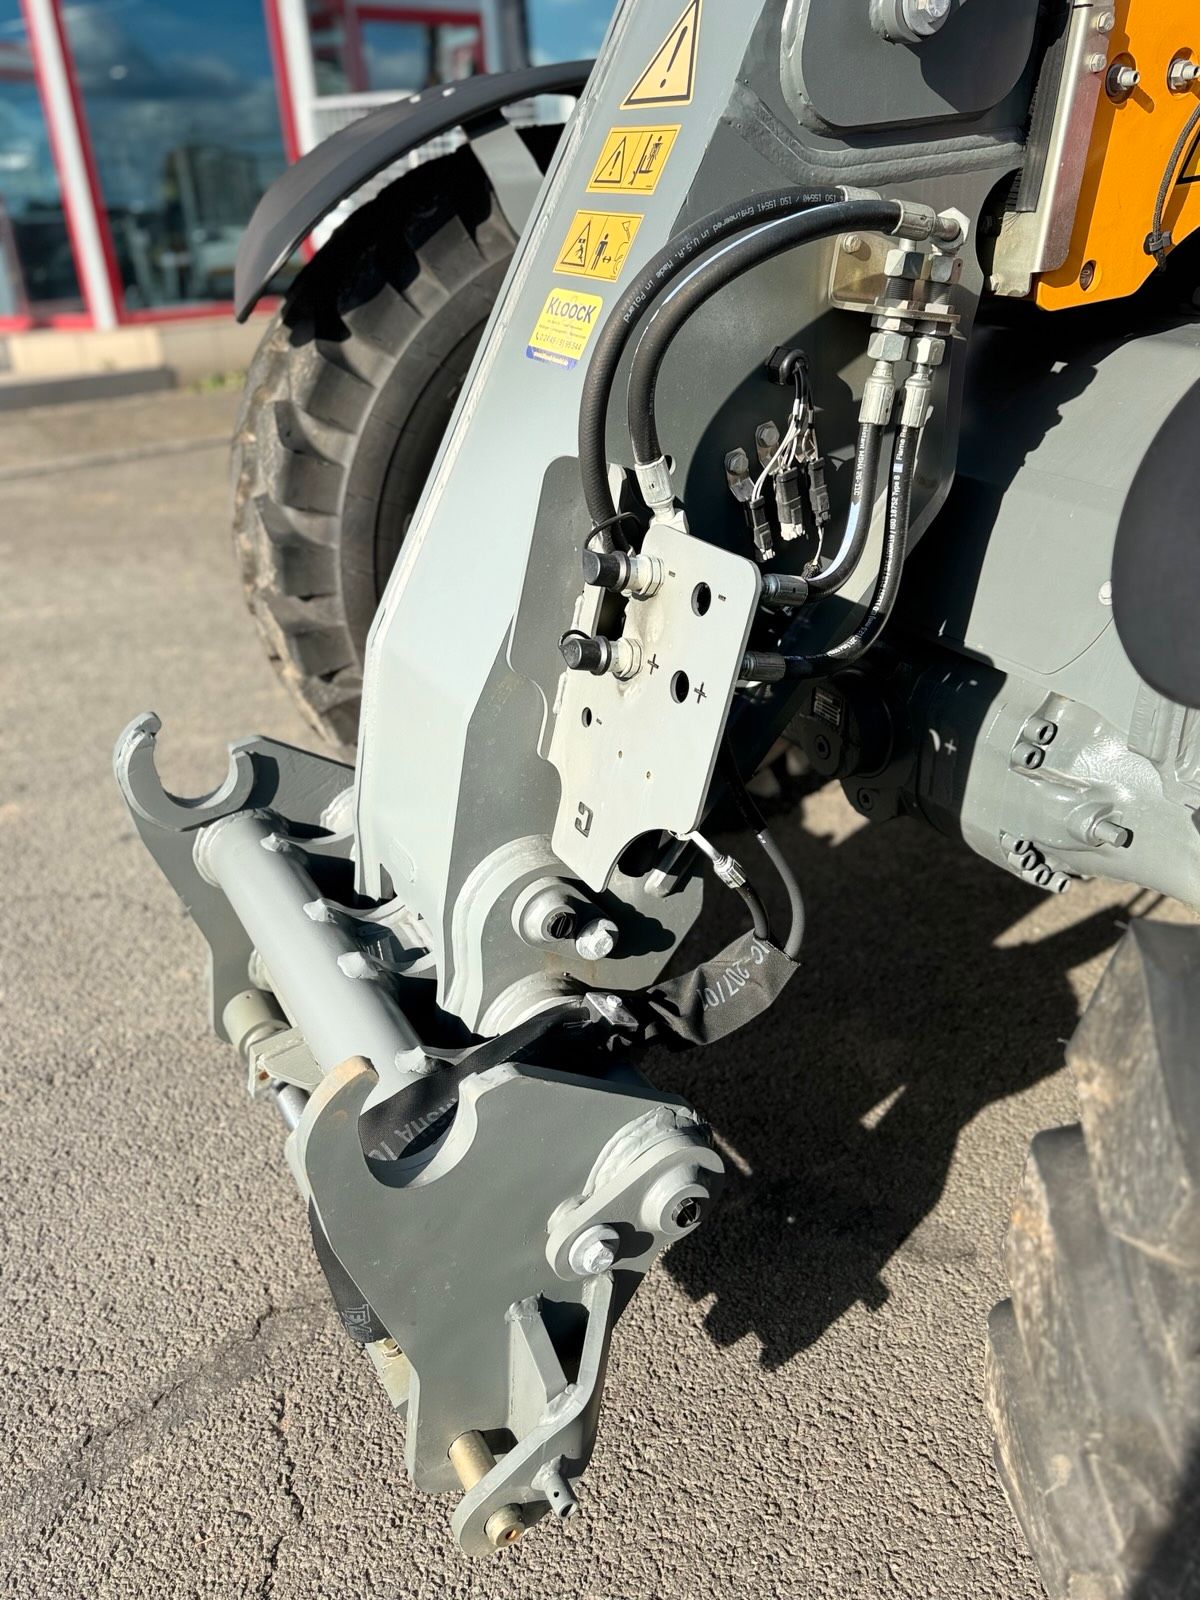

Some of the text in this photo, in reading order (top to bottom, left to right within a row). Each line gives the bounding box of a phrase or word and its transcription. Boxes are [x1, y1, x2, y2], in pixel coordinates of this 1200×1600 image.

[757, 198, 776, 210] 15541
[780, 196, 792, 206] ISO
[825, 194, 837, 202] ISO
[713, 206, 754, 232] Engineered
[700, 229, 709, 239] in
[674, 238, 699, 258] U.S.A.
[655, 260, 673, 277] Made
[644, 280, 654, 290] in
[546, 297, 597, 324] KLOOCK
[623, 290, 647, 323] Poland
[860, 424, 868, 450] sistant
[892, 482, 900, 496] Type
[896, 439, 906, 460] Flame
